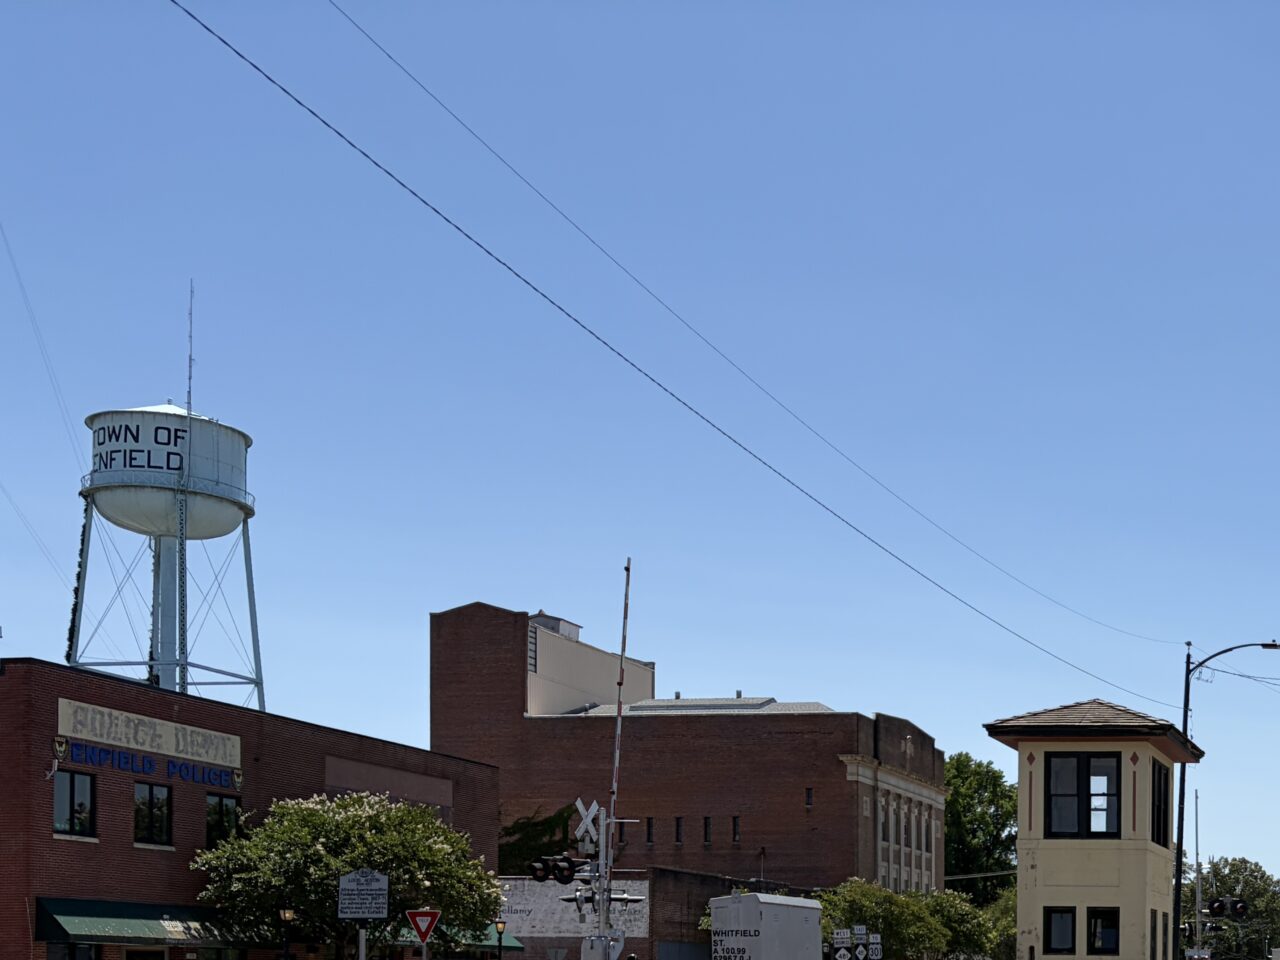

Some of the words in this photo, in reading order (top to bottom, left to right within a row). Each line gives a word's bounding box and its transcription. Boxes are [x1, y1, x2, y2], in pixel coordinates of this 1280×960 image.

[93, 424, 139, 447] TOWN
[154, 426, 187, 447] OF
[93, 449, 184, 472] ENFIELD
[70, 742, 157, 774] ENFIELD
[167, 760, 231, 788] POLICE
[869, 948, 882, 957] 301
